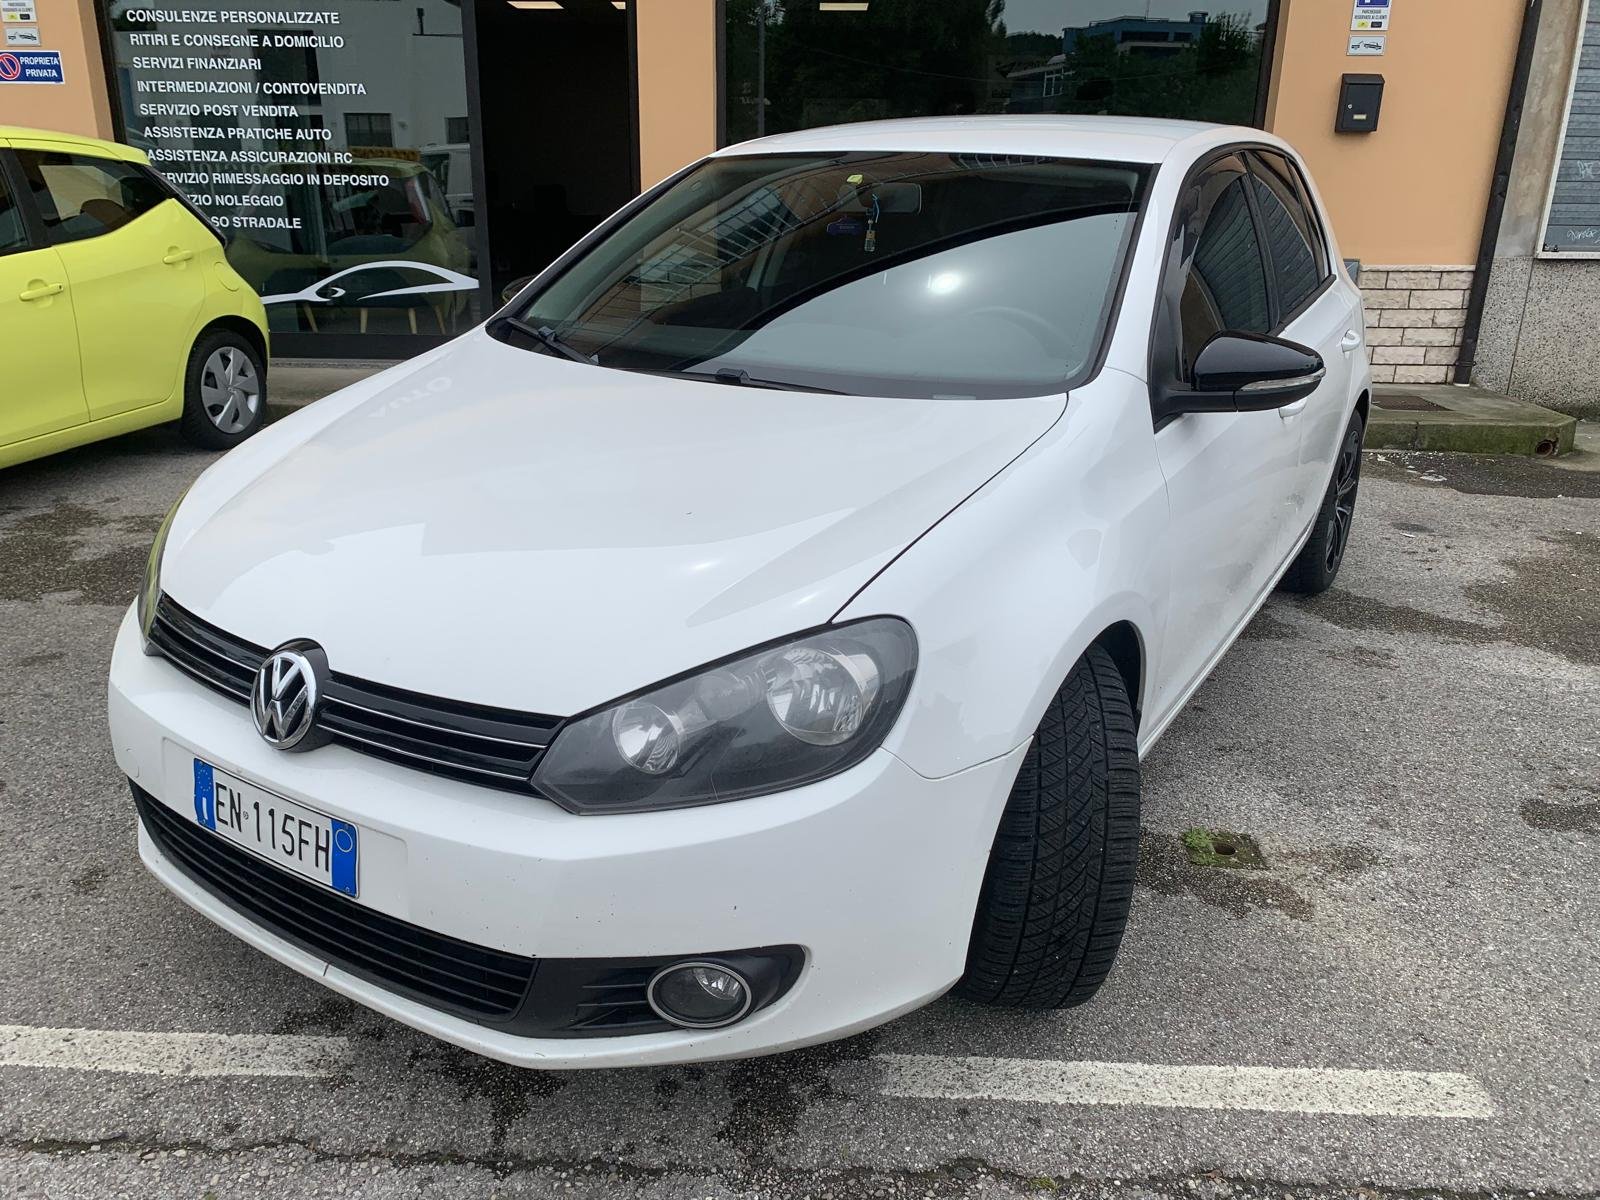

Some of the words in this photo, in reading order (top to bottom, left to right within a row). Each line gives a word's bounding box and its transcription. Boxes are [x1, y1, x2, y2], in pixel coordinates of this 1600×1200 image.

[126, 9, 218, 23] CONSULENZE
[220, 11, 340, 24] PERSONALIZZATE
[129, 33, 168, 46] RITIRI
[171, 34, 181, 46] E
[183, 34, 260, 47] CONSEGNE
[262, 35, 272, 47] A
[274, 35, 344, 48] DOMICILIO
[132, 56, 184, 69] SERVIZI
[186, 57, 262, 70] FINANZIARI
[25, 68, 58, 78] PRIVATA
[137, 80, 252, 94] INTERMEDIAZIONI
[263, 82, 367, 95] CONTOVENDITA
[140, 103, 200, 116] SERVIZIO
[203, 104, 239, 117] POST
[241, 105, 299, 118] VENDITA
[143, 126, 225, 139] ASSISTENZA
[227, 127, 293, 140] PRATICHE
[295, 128, 332, 141] AUTO
[147, 149, 228, 162] ASSISTENZA
[230, 150, 331, 164] ASSICURAZIONI
[334, 152, 353, 164] RC
[160, 172, 209, 184] RVIZIO
[212, 172, 304, 186] RIMESSAGGIO
[307, 174, 320, 185] IN
[323, 174, 389, 187] DEPOSITO
[215, 194, 284, 207] NOLEGGIO
[232, 216, 302, 229] STRADALE
[215, 781, 242, 833] EN
[253, 801, 331, 873] 115FH
